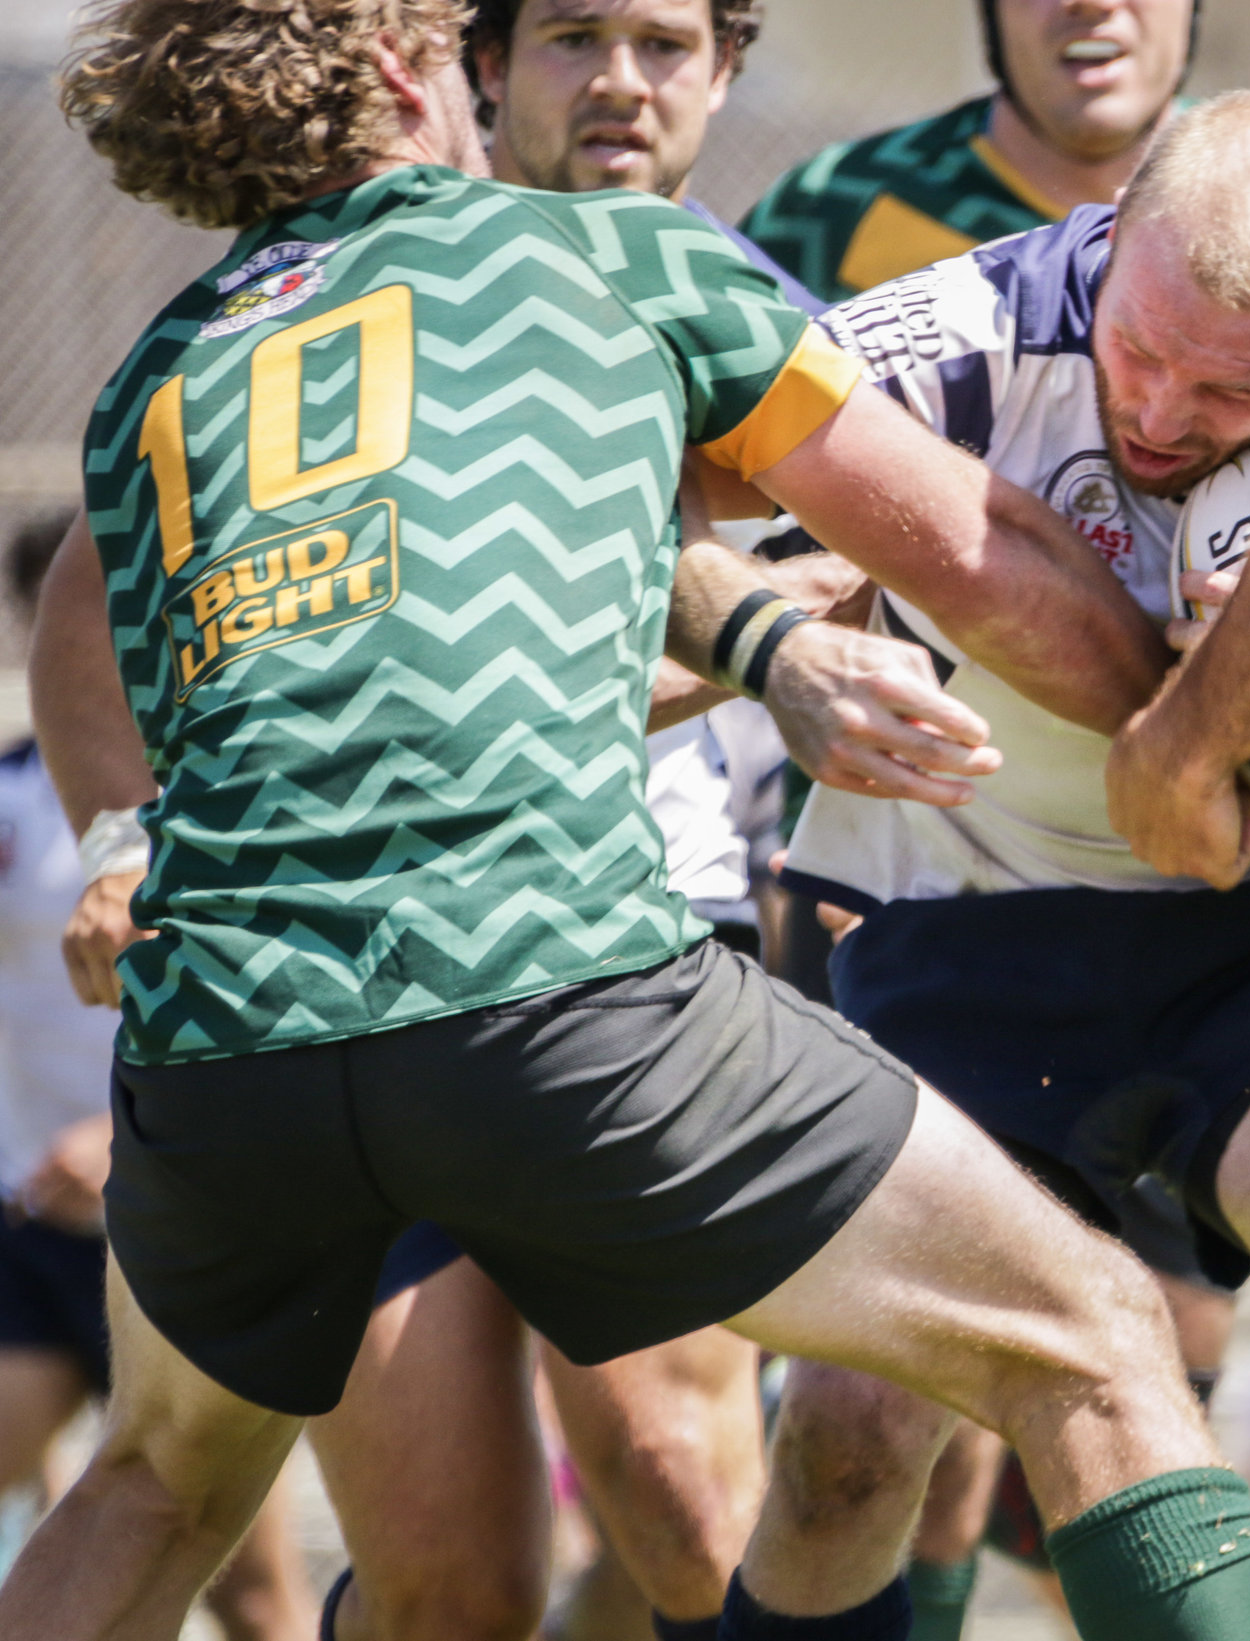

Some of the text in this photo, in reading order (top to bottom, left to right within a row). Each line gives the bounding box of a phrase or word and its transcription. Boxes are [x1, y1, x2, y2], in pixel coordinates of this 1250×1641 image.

[137, 283, 413, 579] 10
[180, 555, 388, 688] LIGHT
[190, 529, 349, 627] BUD
